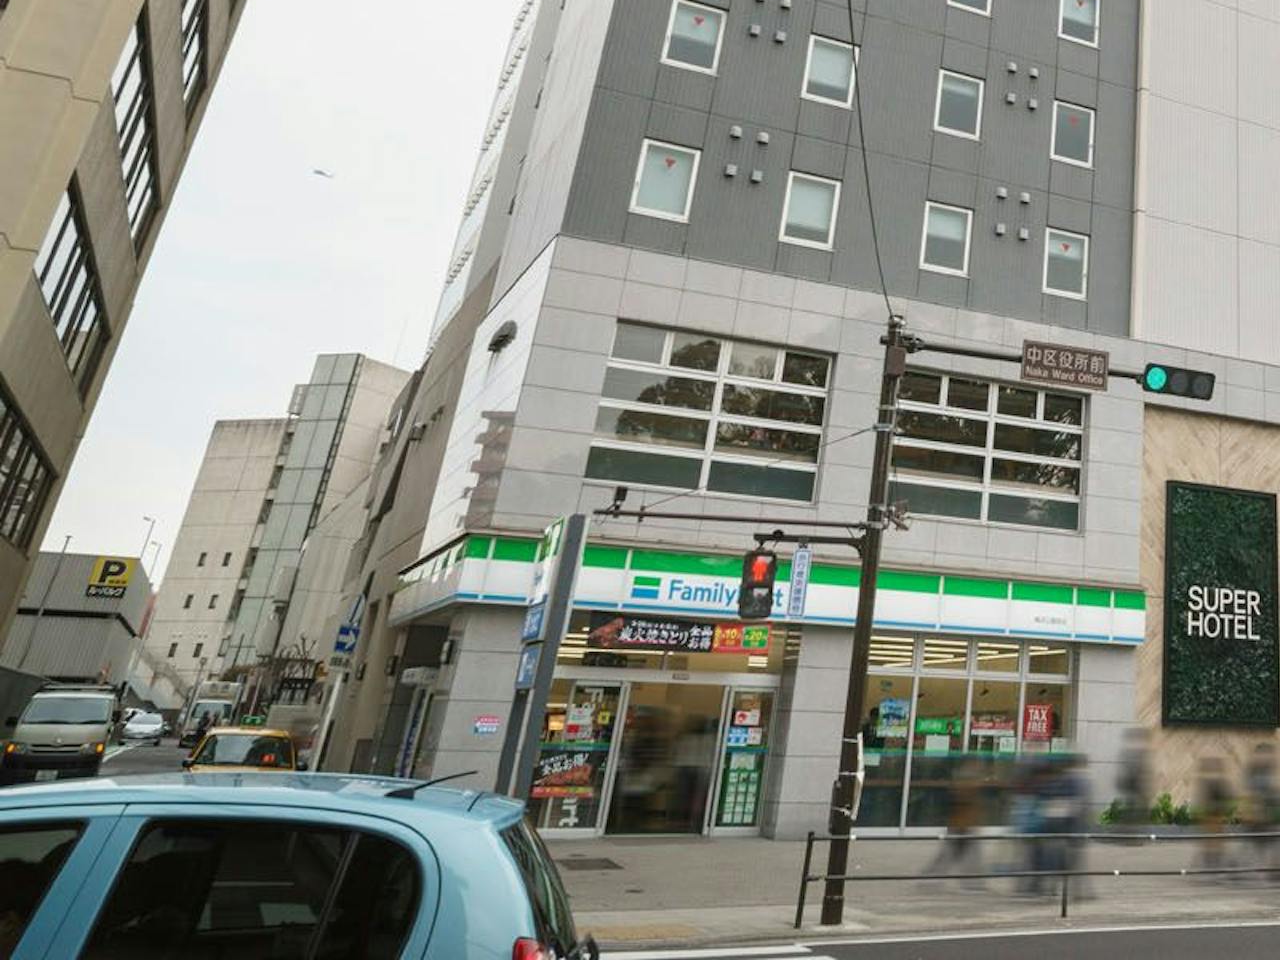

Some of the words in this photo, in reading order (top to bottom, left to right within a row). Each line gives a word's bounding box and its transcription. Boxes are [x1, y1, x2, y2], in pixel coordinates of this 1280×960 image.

[1026, 345, 1105, 374] 中区役所前
[1026, 365, 1049, 378] Naka
[1052, 368, 1075, 381] Ward
[1077, 372, 1104, 385] Office
[99, 560, 127, 583] P
[667, 578, 784, 608] Familyt
[1188, 585, 1261, 616] SUPER
[1187, 611, 1261, 640] HOTEL
[1027, 721, 1048, 733] FREE
[1028, 707, 1048, 721] TAX
